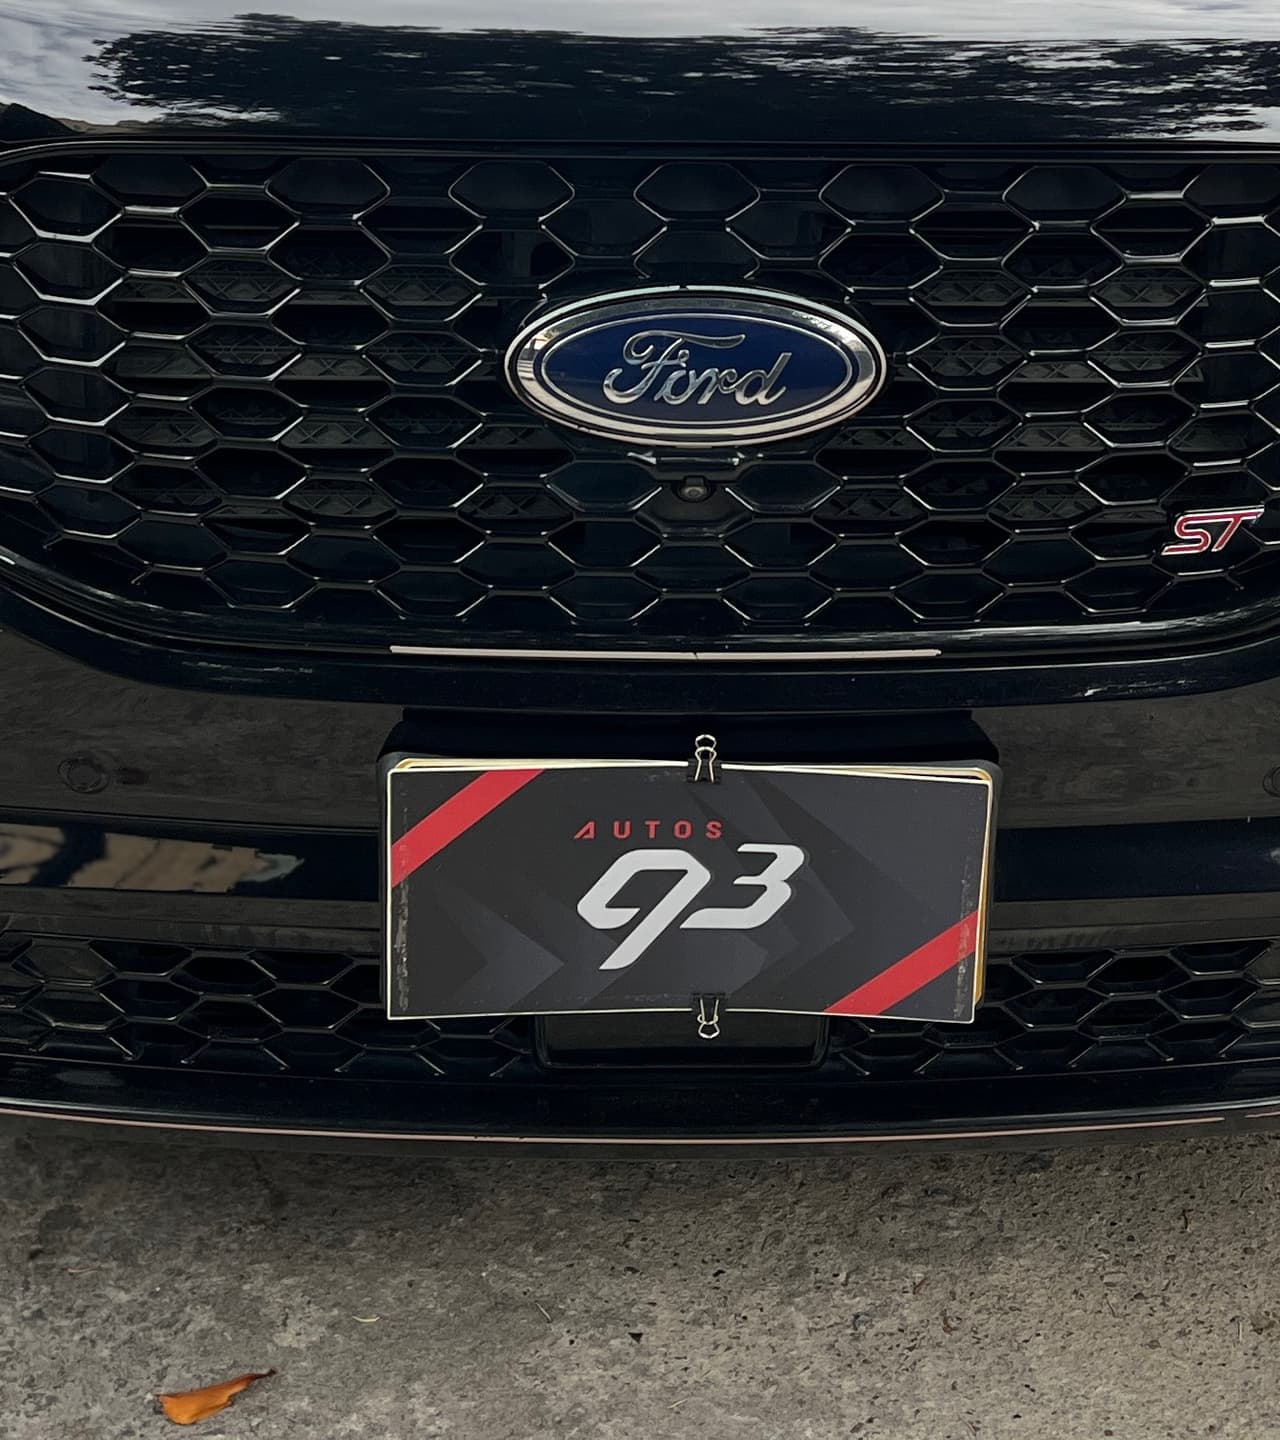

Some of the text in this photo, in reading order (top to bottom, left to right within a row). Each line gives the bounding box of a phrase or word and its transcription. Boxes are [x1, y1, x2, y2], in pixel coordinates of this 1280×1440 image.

[603, 329, 793, 406] Ford
[1161, 506, 1265, 556] ST
[574, 819, 723, 839] AUTOS
[577, 843, 805, 970] 93
